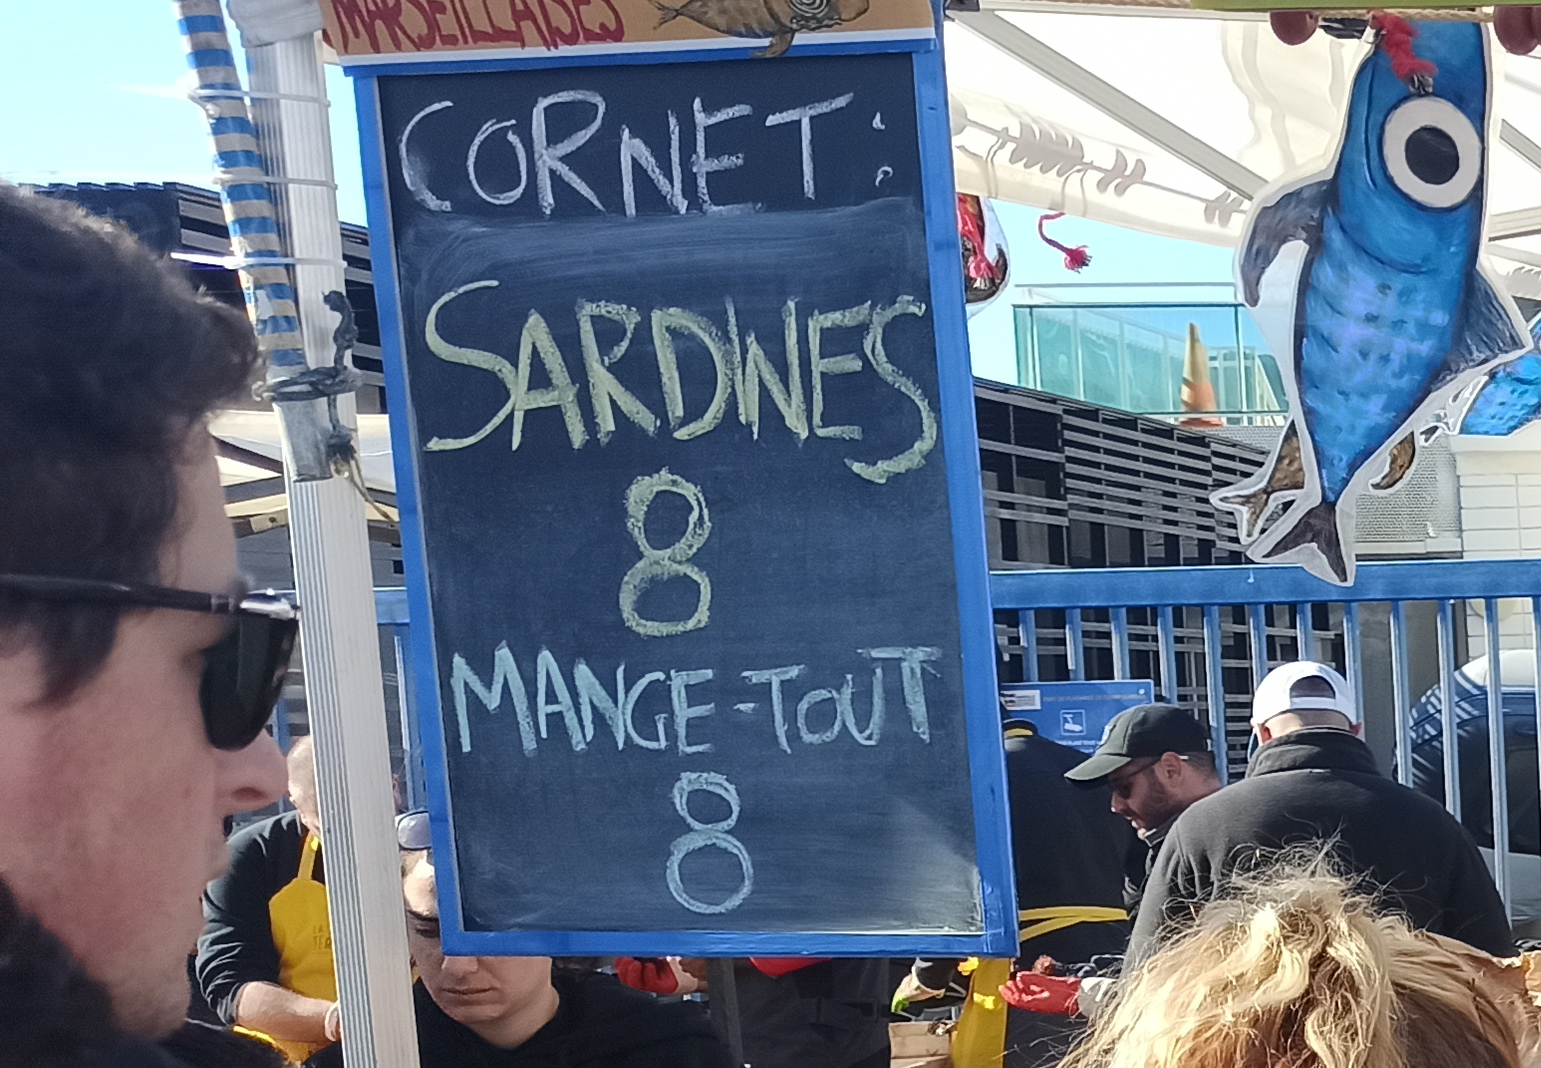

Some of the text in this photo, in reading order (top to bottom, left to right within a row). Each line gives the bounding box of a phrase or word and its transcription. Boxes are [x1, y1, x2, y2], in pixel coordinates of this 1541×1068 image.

[423, 279, 938, 484] SARDINES
[619, 465, 712, 637] 8
[448, 640, 944, 757] MANGE-TOUT
[665, 771, 754, 914] 8
